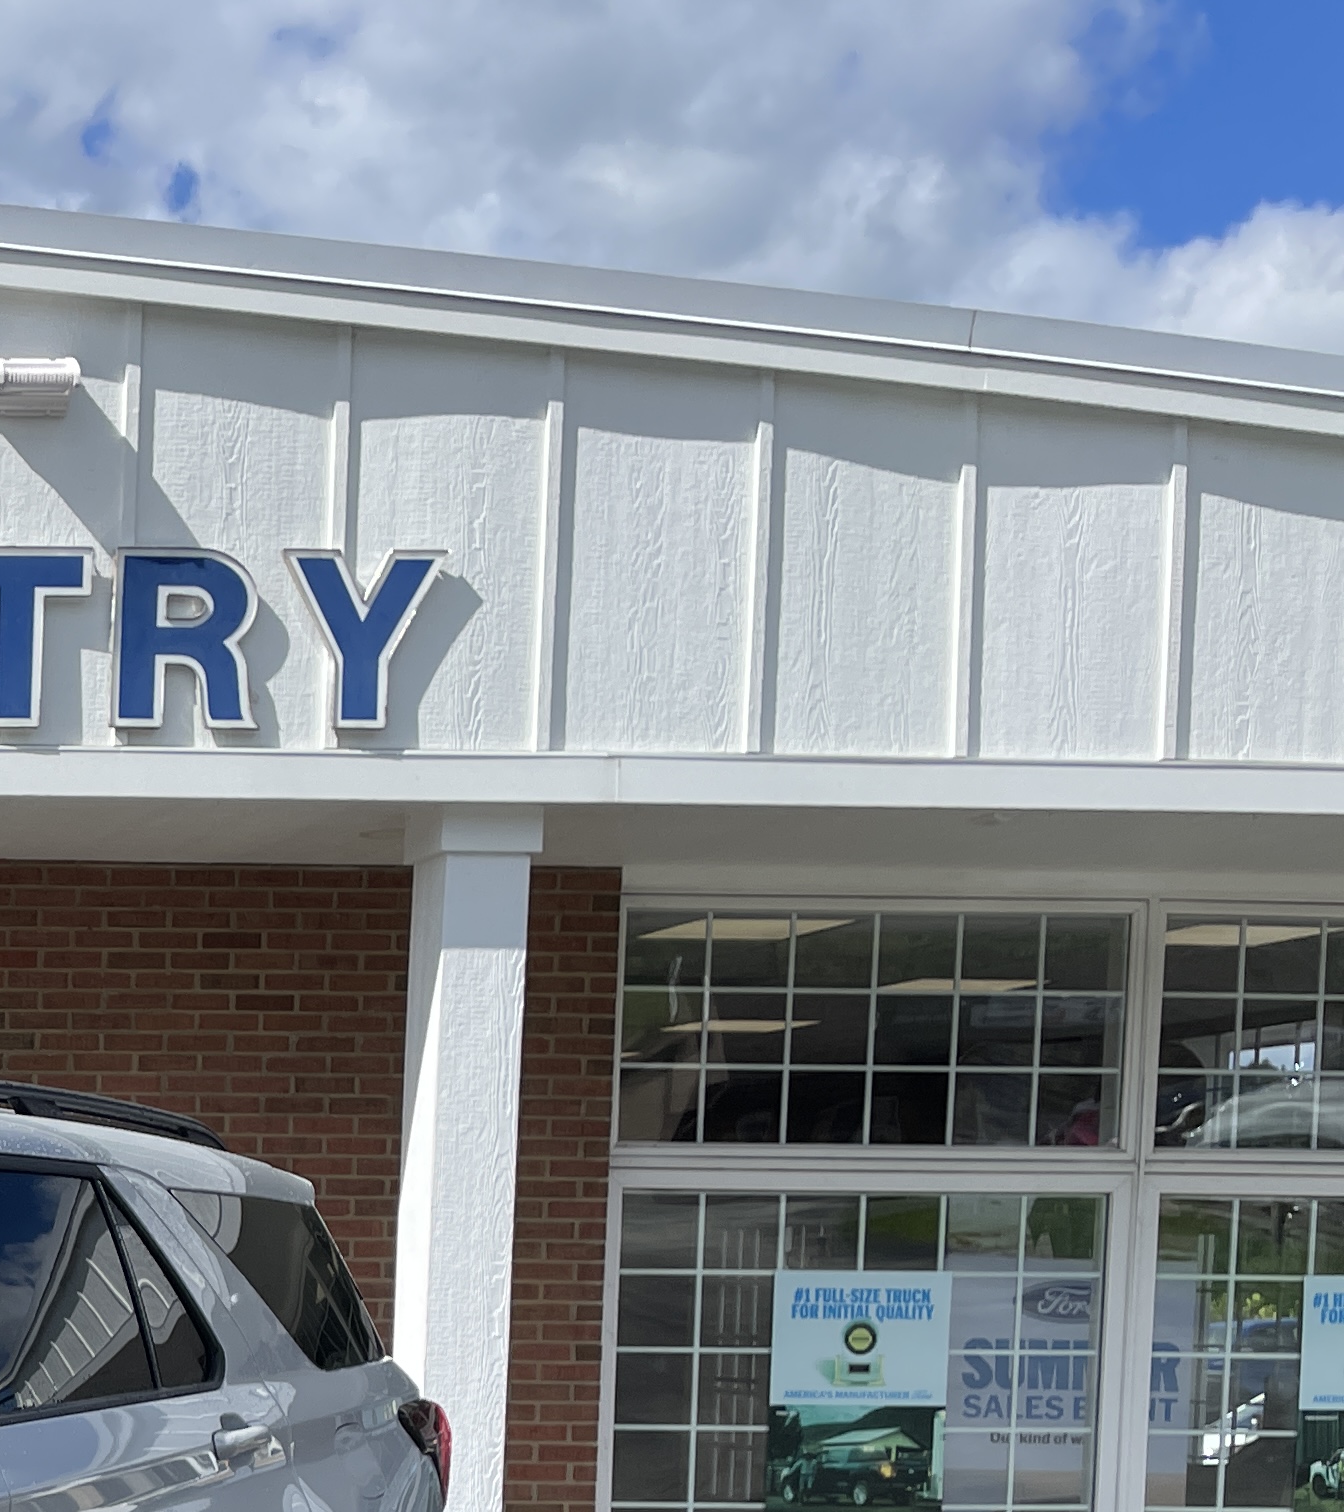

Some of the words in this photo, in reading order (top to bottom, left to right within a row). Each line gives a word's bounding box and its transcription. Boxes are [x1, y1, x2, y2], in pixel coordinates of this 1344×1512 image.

[793, 1287, 811, 1304] #1
[814, 1287, 882, 1304] FULL-SIZE
[884, 1288, 932, 1304] TRUCK
[1037, 1286, 1090, 1315] For
[1313, 1292, 1329, 1308] #1
[791, 1303, 819, 1320] FOR
[822, 1304, 872, 1320] INITIAL
[875, 1304, 935, 1323] QUALITY
[1019, 1432, 1051, 1445] kind
[1053, 1432, 1068, 1445] of
